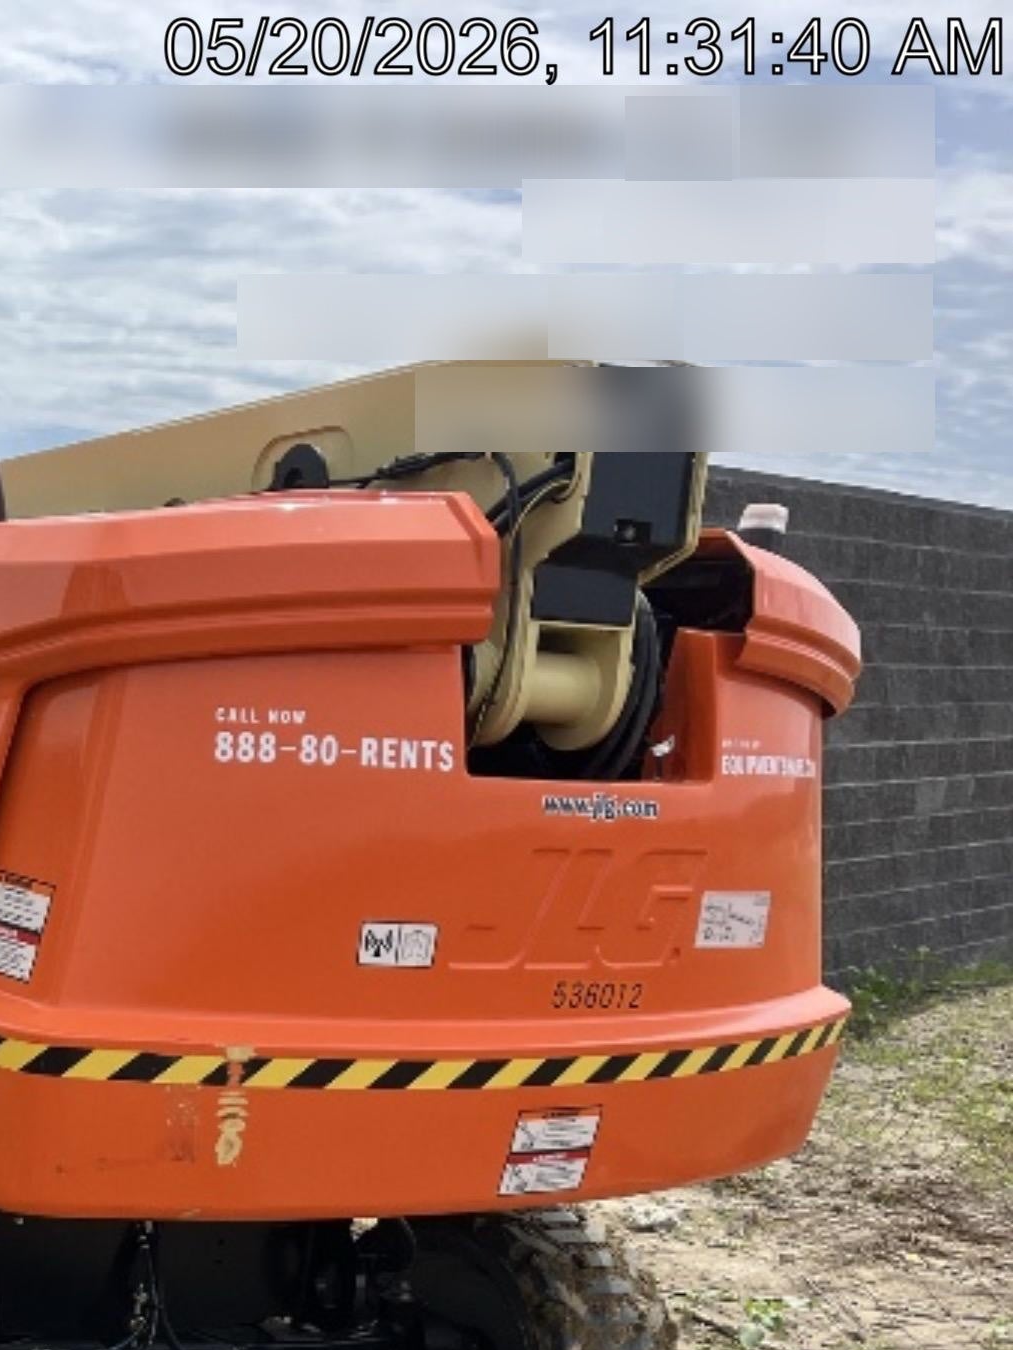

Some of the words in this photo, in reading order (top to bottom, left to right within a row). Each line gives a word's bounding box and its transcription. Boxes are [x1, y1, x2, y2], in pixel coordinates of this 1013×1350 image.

[215, 707, 259, 723] CALL
[268, 710, 306, 724] NOW
[215, 731, 454, 772] 888-80-RENTS
[552, 981, 643, 1010] 536012
